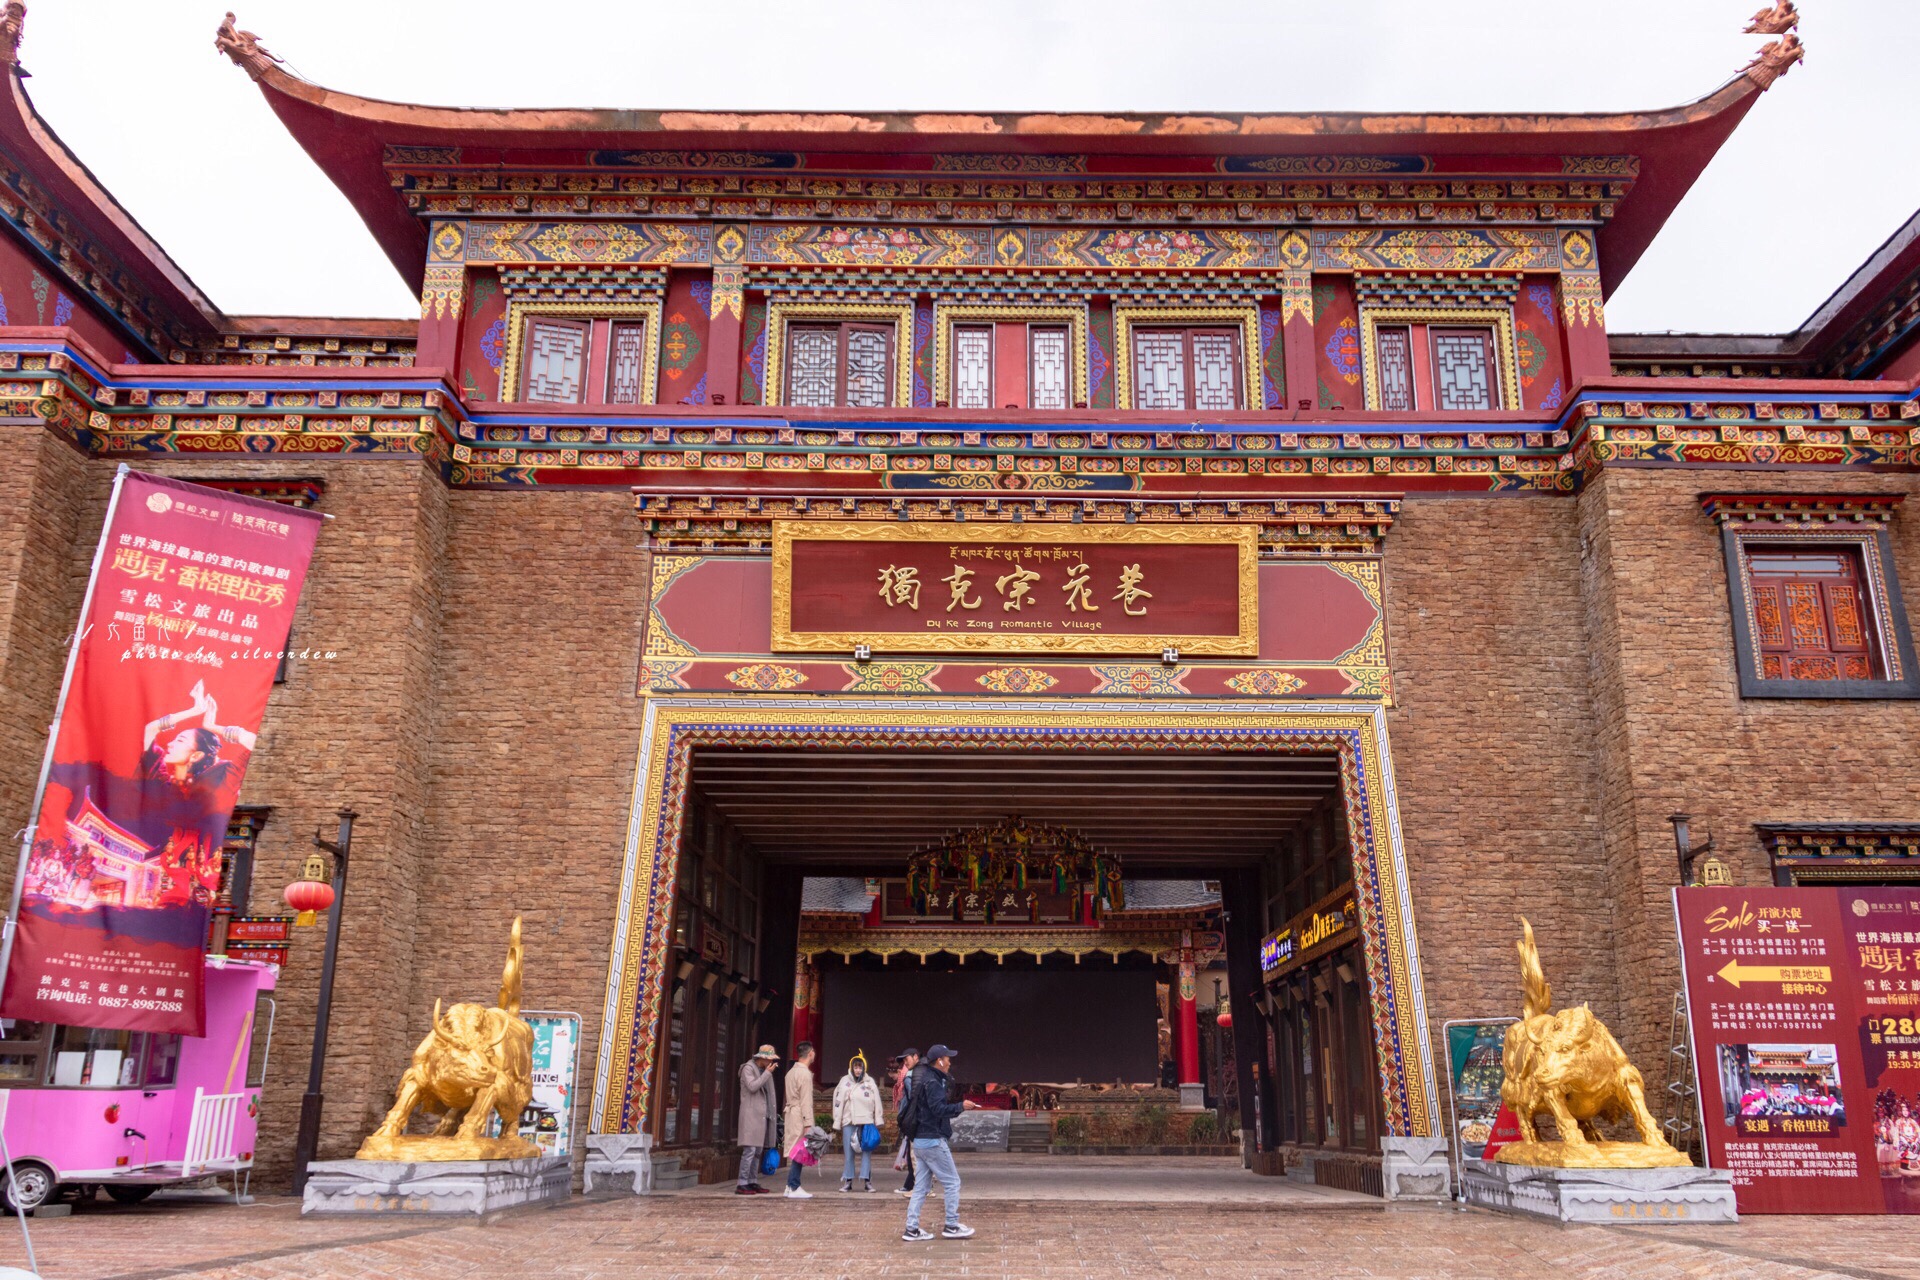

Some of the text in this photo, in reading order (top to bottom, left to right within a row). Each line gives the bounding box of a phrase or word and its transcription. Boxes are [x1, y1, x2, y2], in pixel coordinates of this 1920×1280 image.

[119, 533, 291, 580] 世界海拔最高的室内歌舞剧
[119, 588, 260, 629] 雪松文旅出品
[946, 619, 959, 628] Ke
[966, 619, 994, 630] Zong
[1000, 620, 1053, 629] Romantic
[1061, 620, 1102, 631] Village
[1703, 900, 1758, 933] Sale
[1758, 907, 1803, 919] 开演大促
[1757, 919, 1813, 934] 买一送一
[1780, 968, 1825, 980] 购票地址
[40, 974, 185, 998] 独克宗花巷大剧院
[1781, 983, 1827, 995] 接待中心
